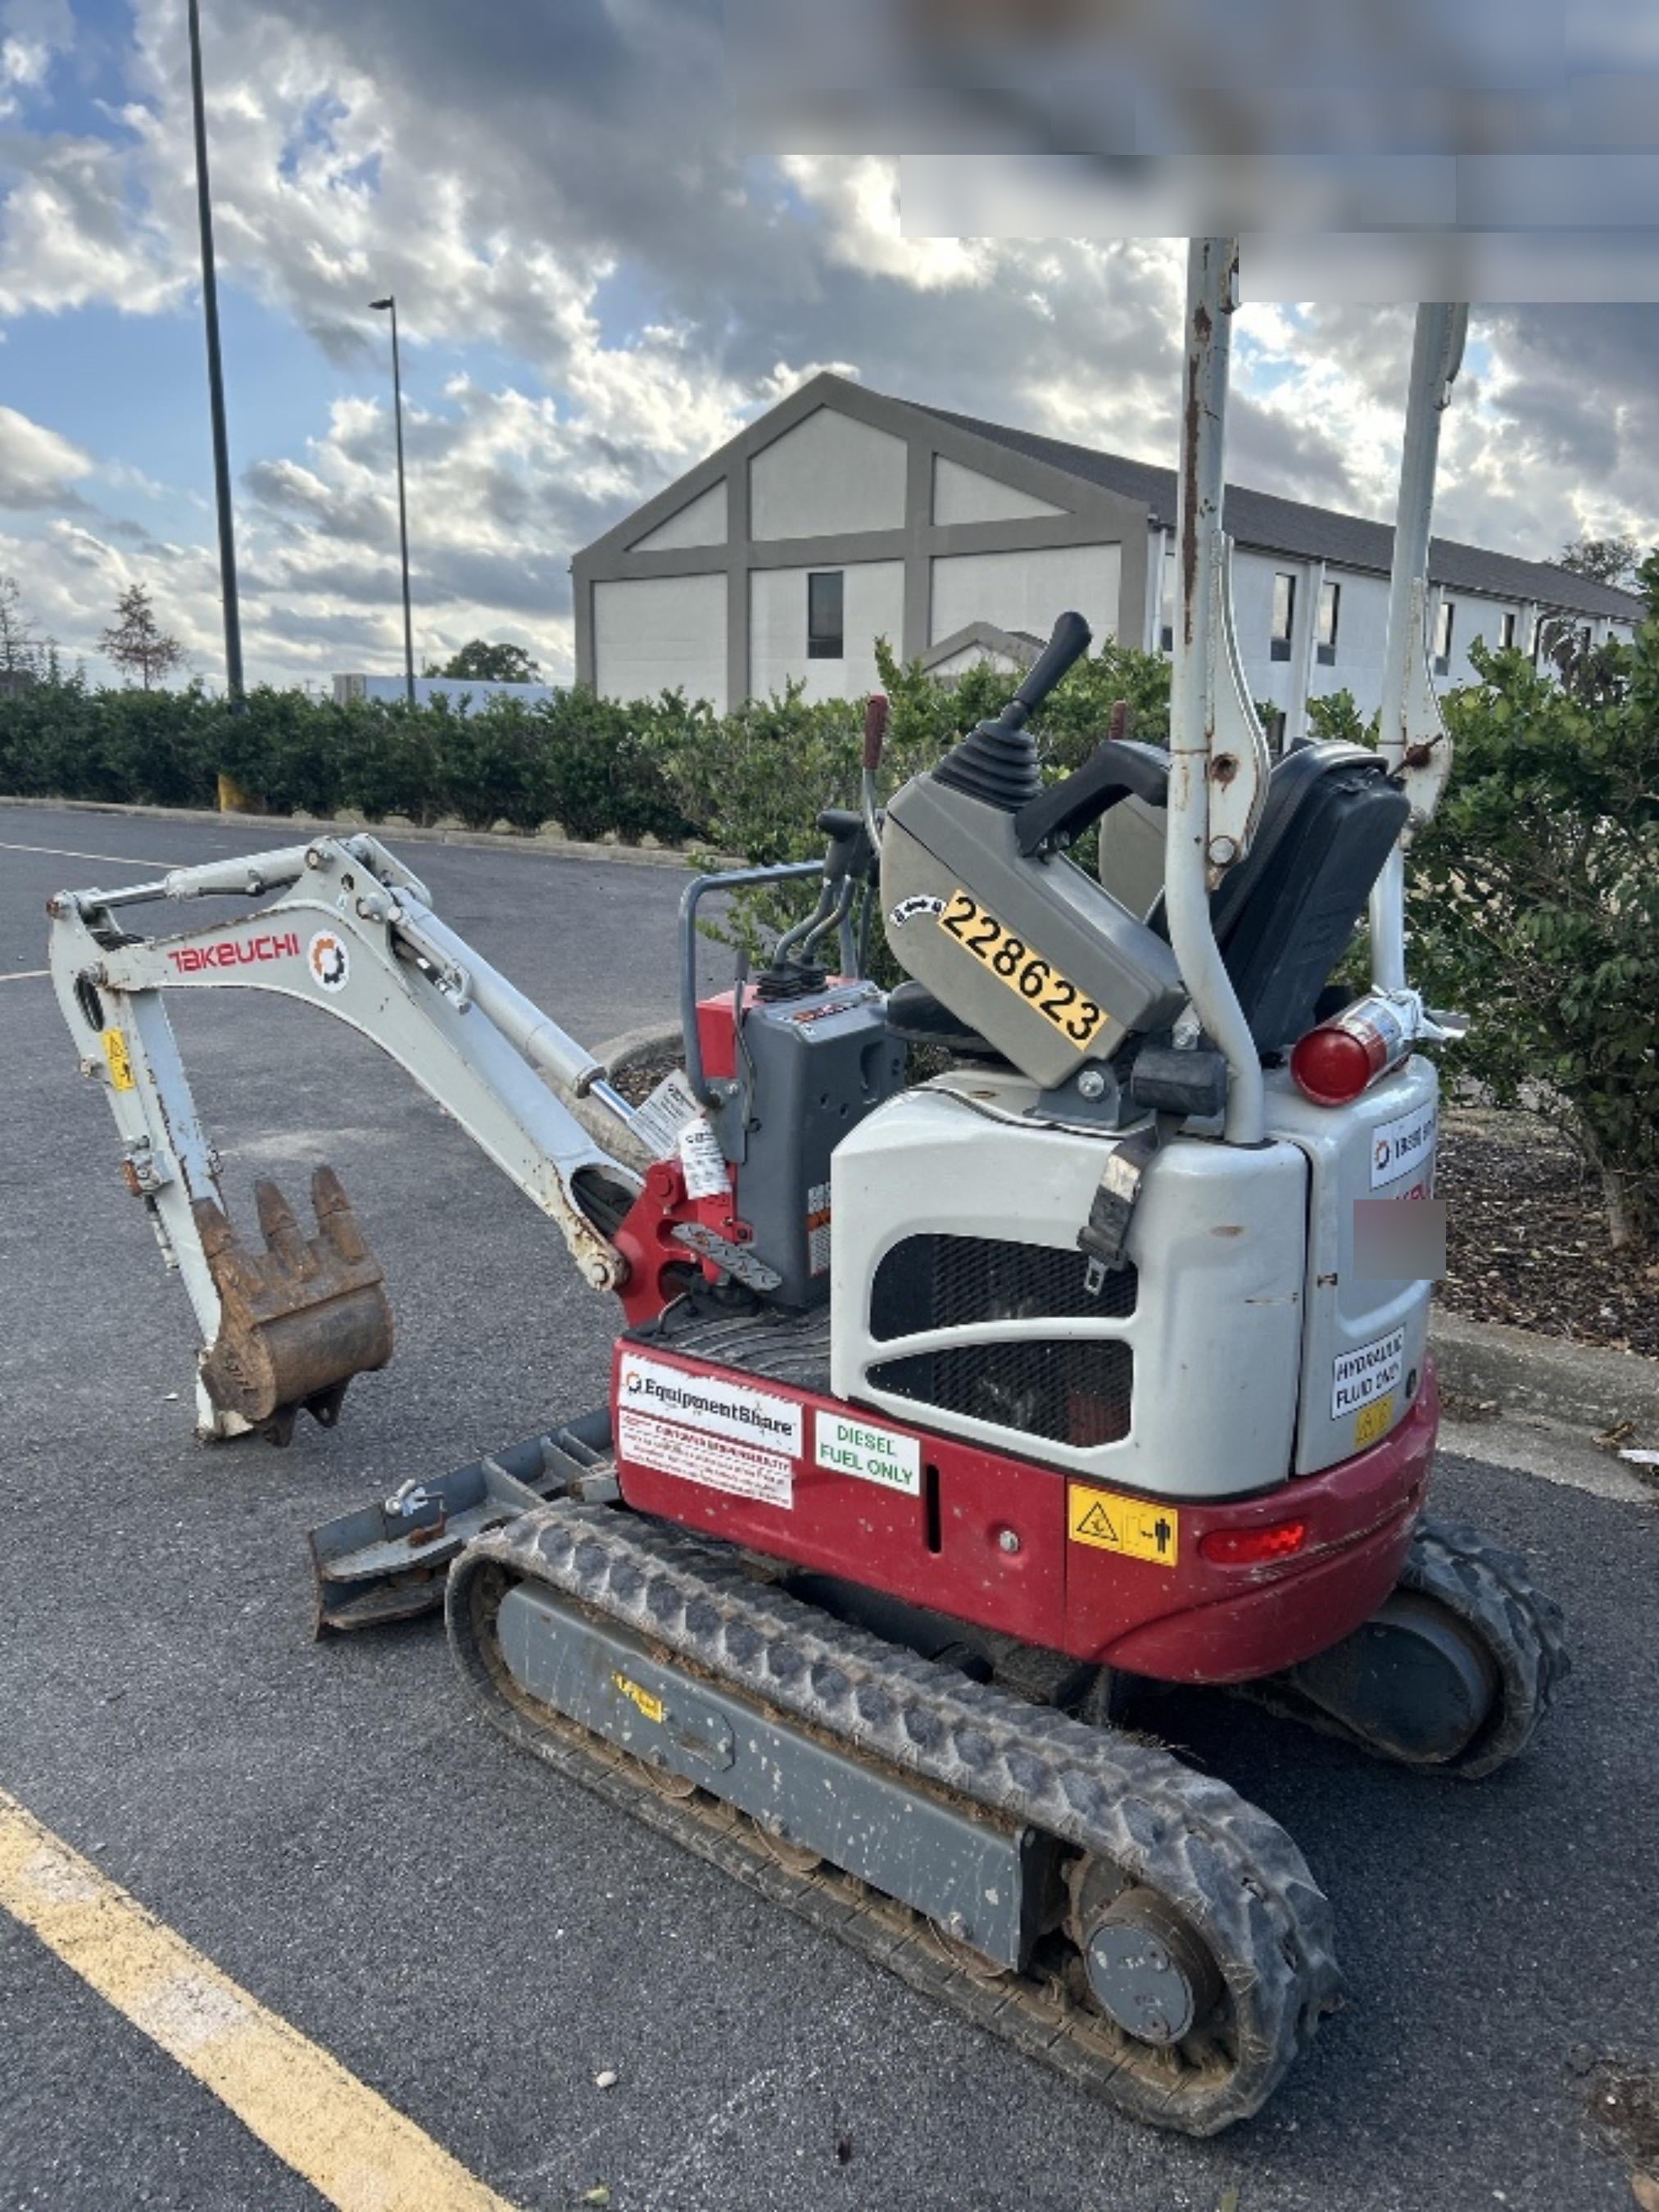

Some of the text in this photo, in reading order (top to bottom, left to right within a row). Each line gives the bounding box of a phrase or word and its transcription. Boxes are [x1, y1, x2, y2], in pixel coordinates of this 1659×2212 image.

[167, 933, 300, 973] TAKEUCHI
[943, 896, 1099, 1040] 228623
[646, 1378, 792, 1436] EquipmentShare
[837, 1425, 896, 1457] DIESEL
[820, 1442, 863, 1471] FUEL
[868, 1459, 913, 1484] ONLY
